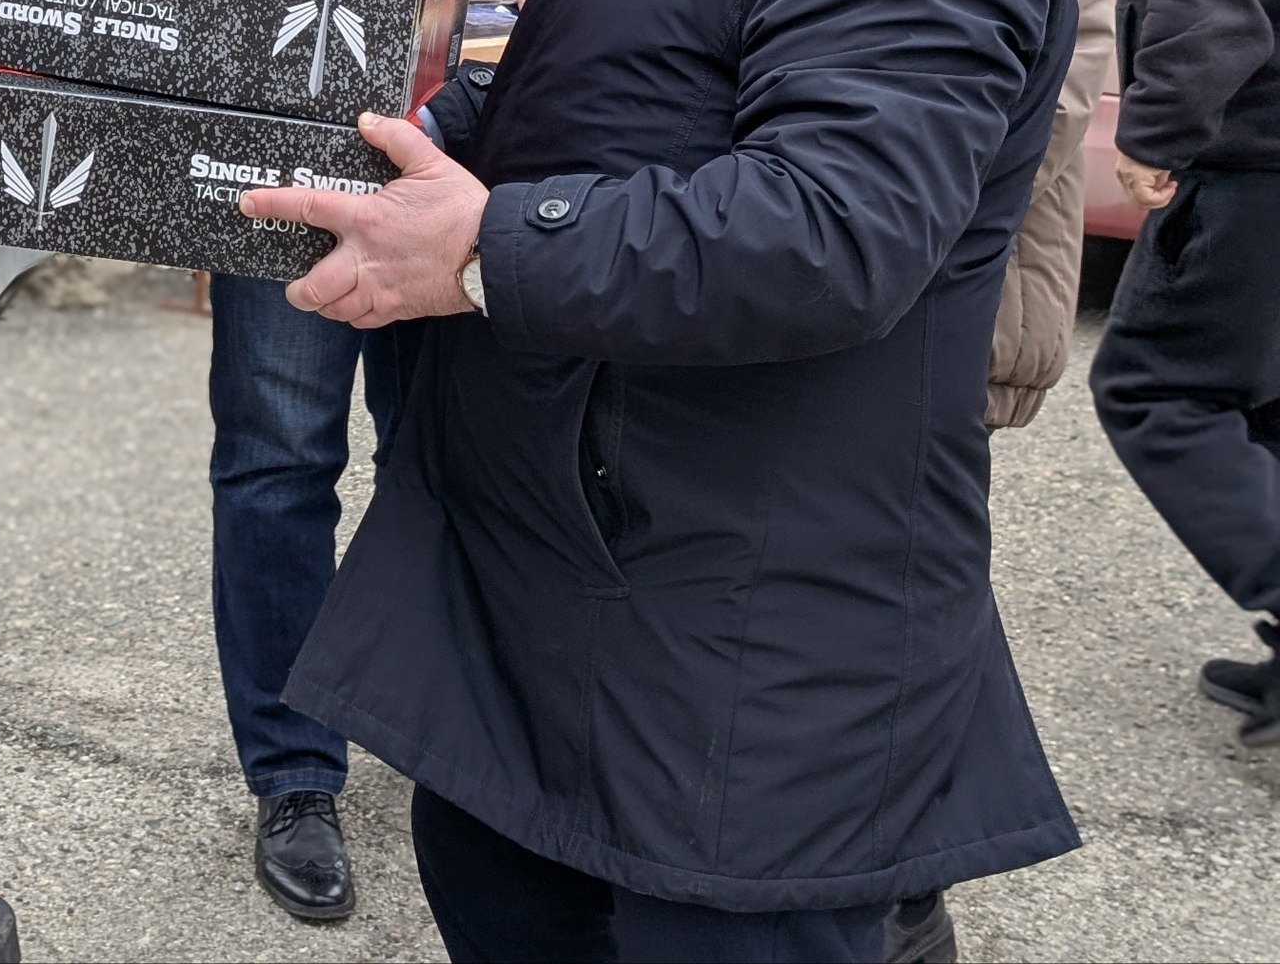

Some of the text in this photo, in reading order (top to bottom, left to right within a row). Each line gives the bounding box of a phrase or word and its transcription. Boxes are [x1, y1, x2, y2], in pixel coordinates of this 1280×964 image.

[93, 16, 179, 51] SINGLE
[189, 153, 281, 187] SINGLE
[252, 217, 308, 235] BOOTS
